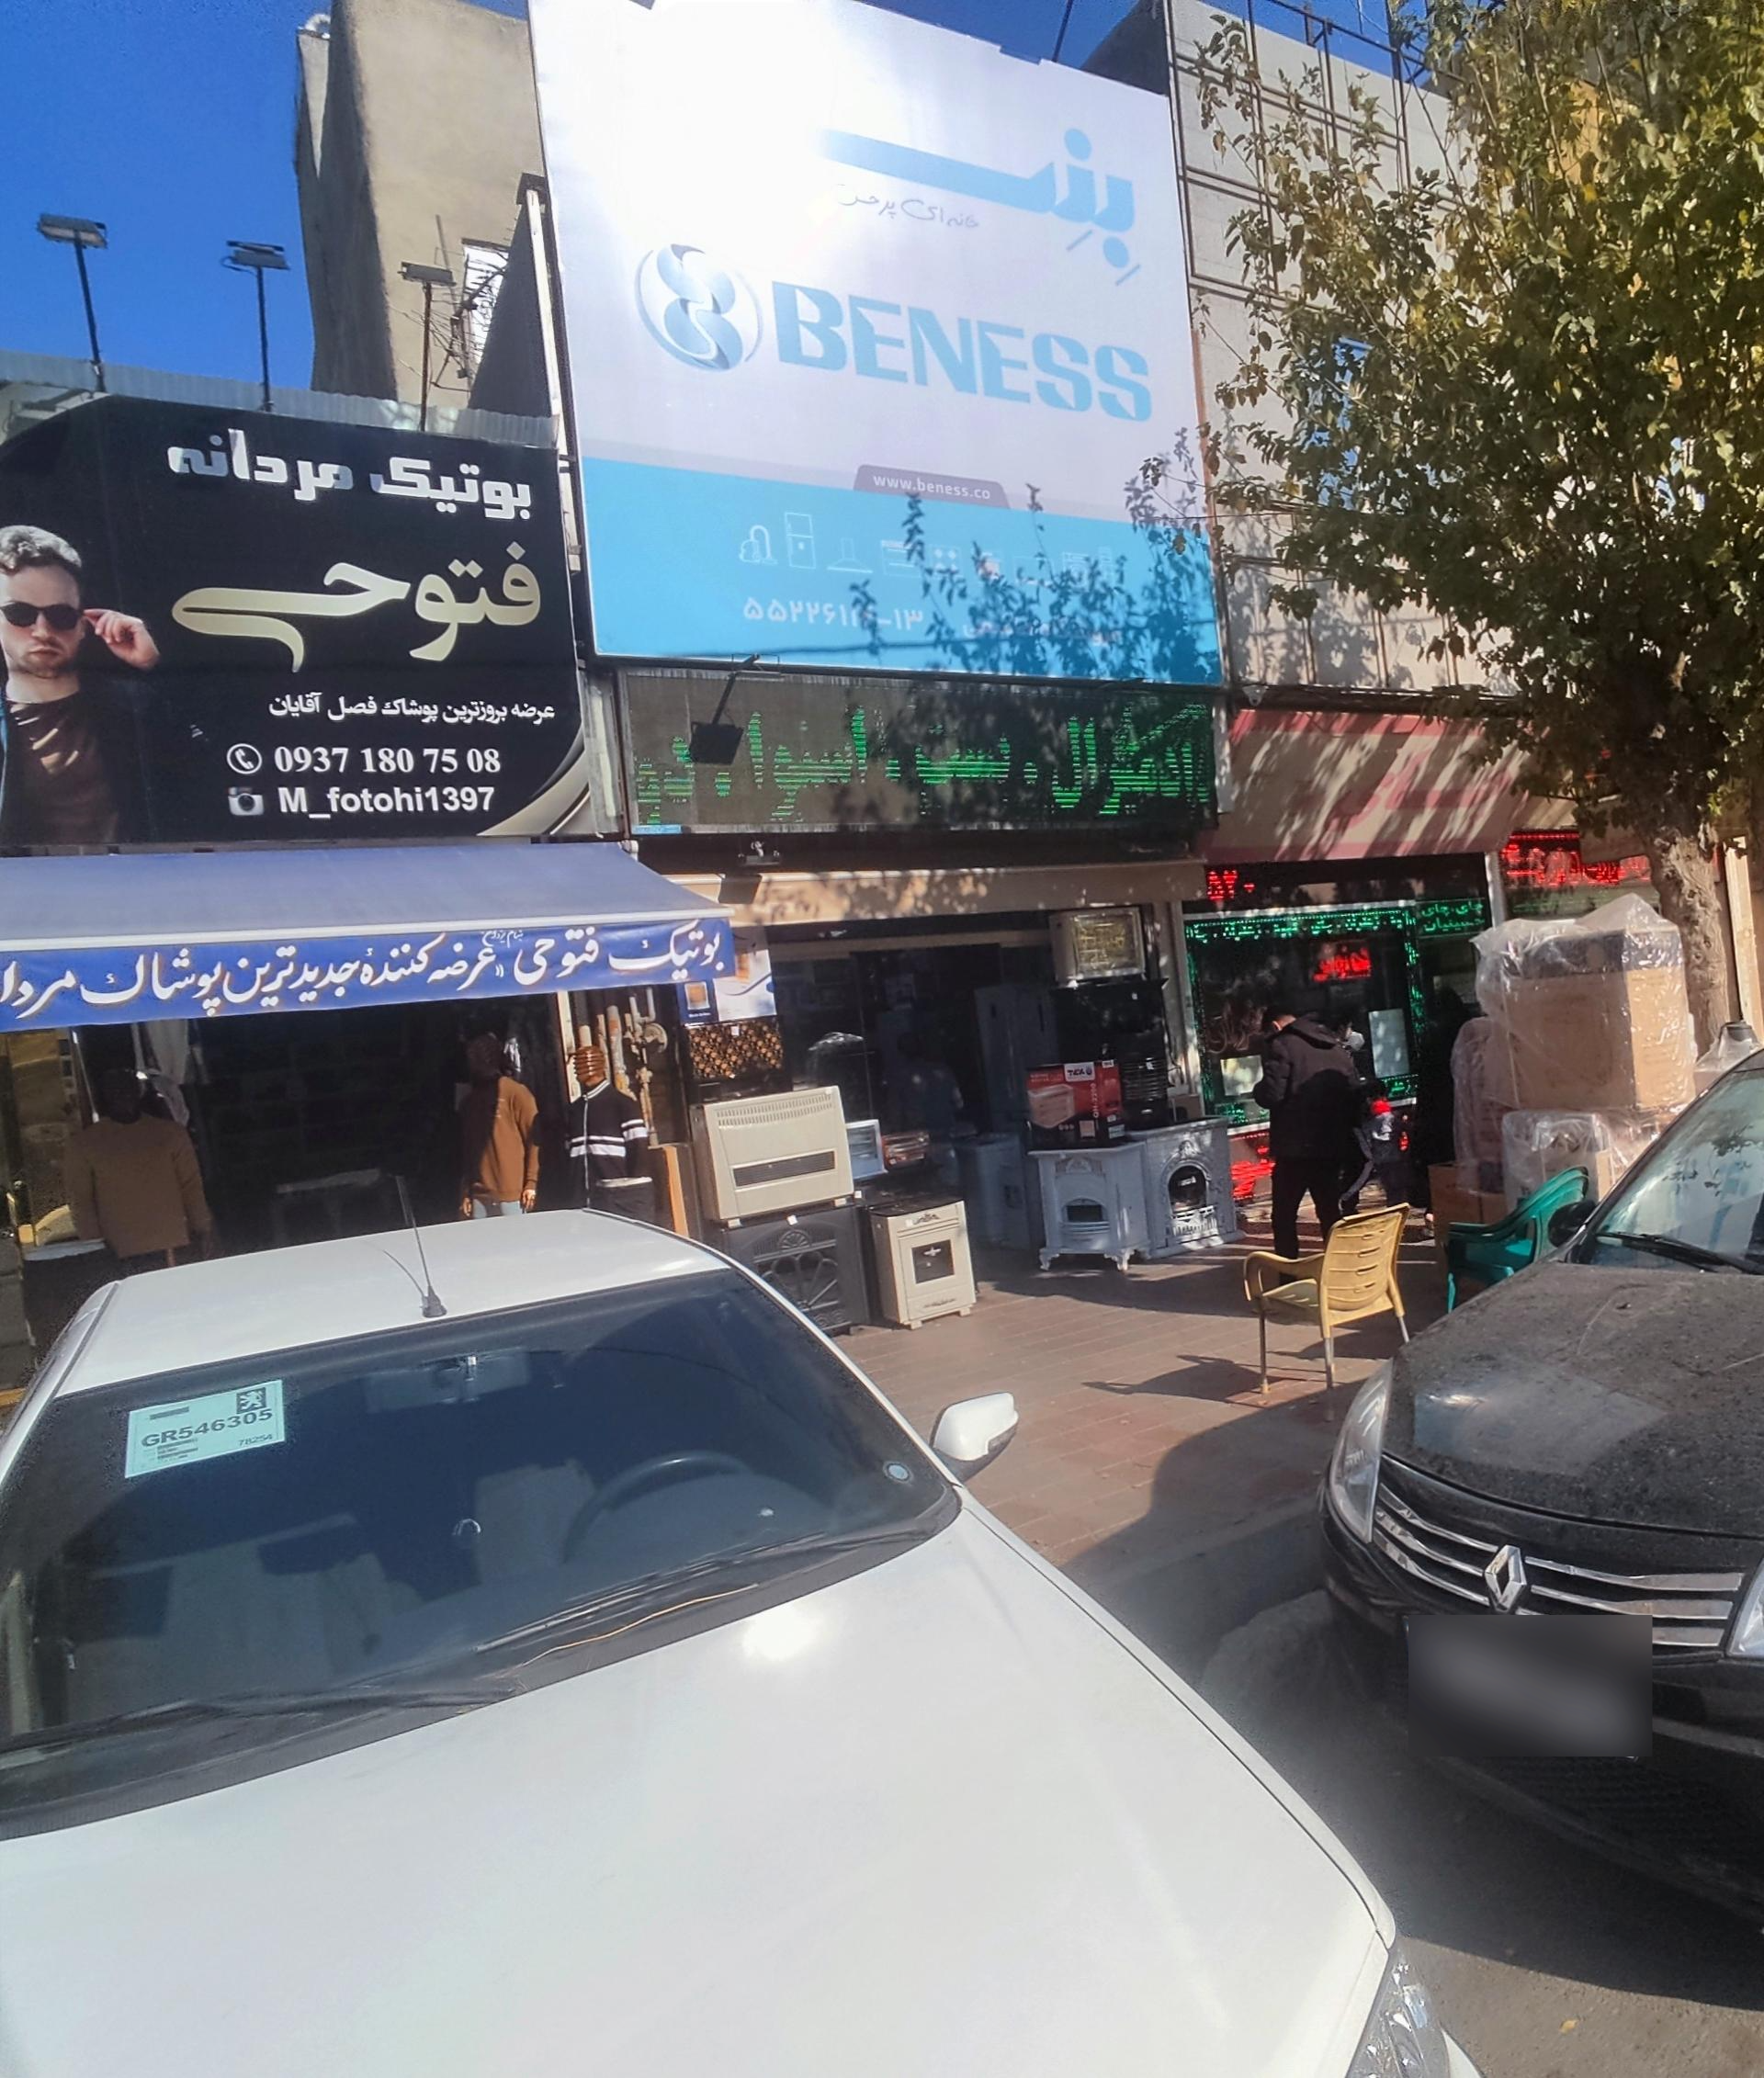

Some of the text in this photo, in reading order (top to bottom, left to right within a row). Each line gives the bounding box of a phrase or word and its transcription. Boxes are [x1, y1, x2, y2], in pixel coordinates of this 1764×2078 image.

[773, 279, 1154, 424] BENESS
[167, 428, 532, 520] بوتیک مردانه
[872, 472, 991, 502] www.beness.co
[172, 541, 542, 673] فتوحی
[268, 691, 323, 718] آقایان
[326, 695, 378, 722] فصل
[442, 700, 508, 725] بروزترین
[511, 701, 556, 725] عرضه
[274, 745, 502, 774] 0937 180 75 08
[277, 786, 496, 819] M_fotohi1397
[513, 926, 600, 986] فتوحی
[141, 1407, 274, 1448] GR546305
